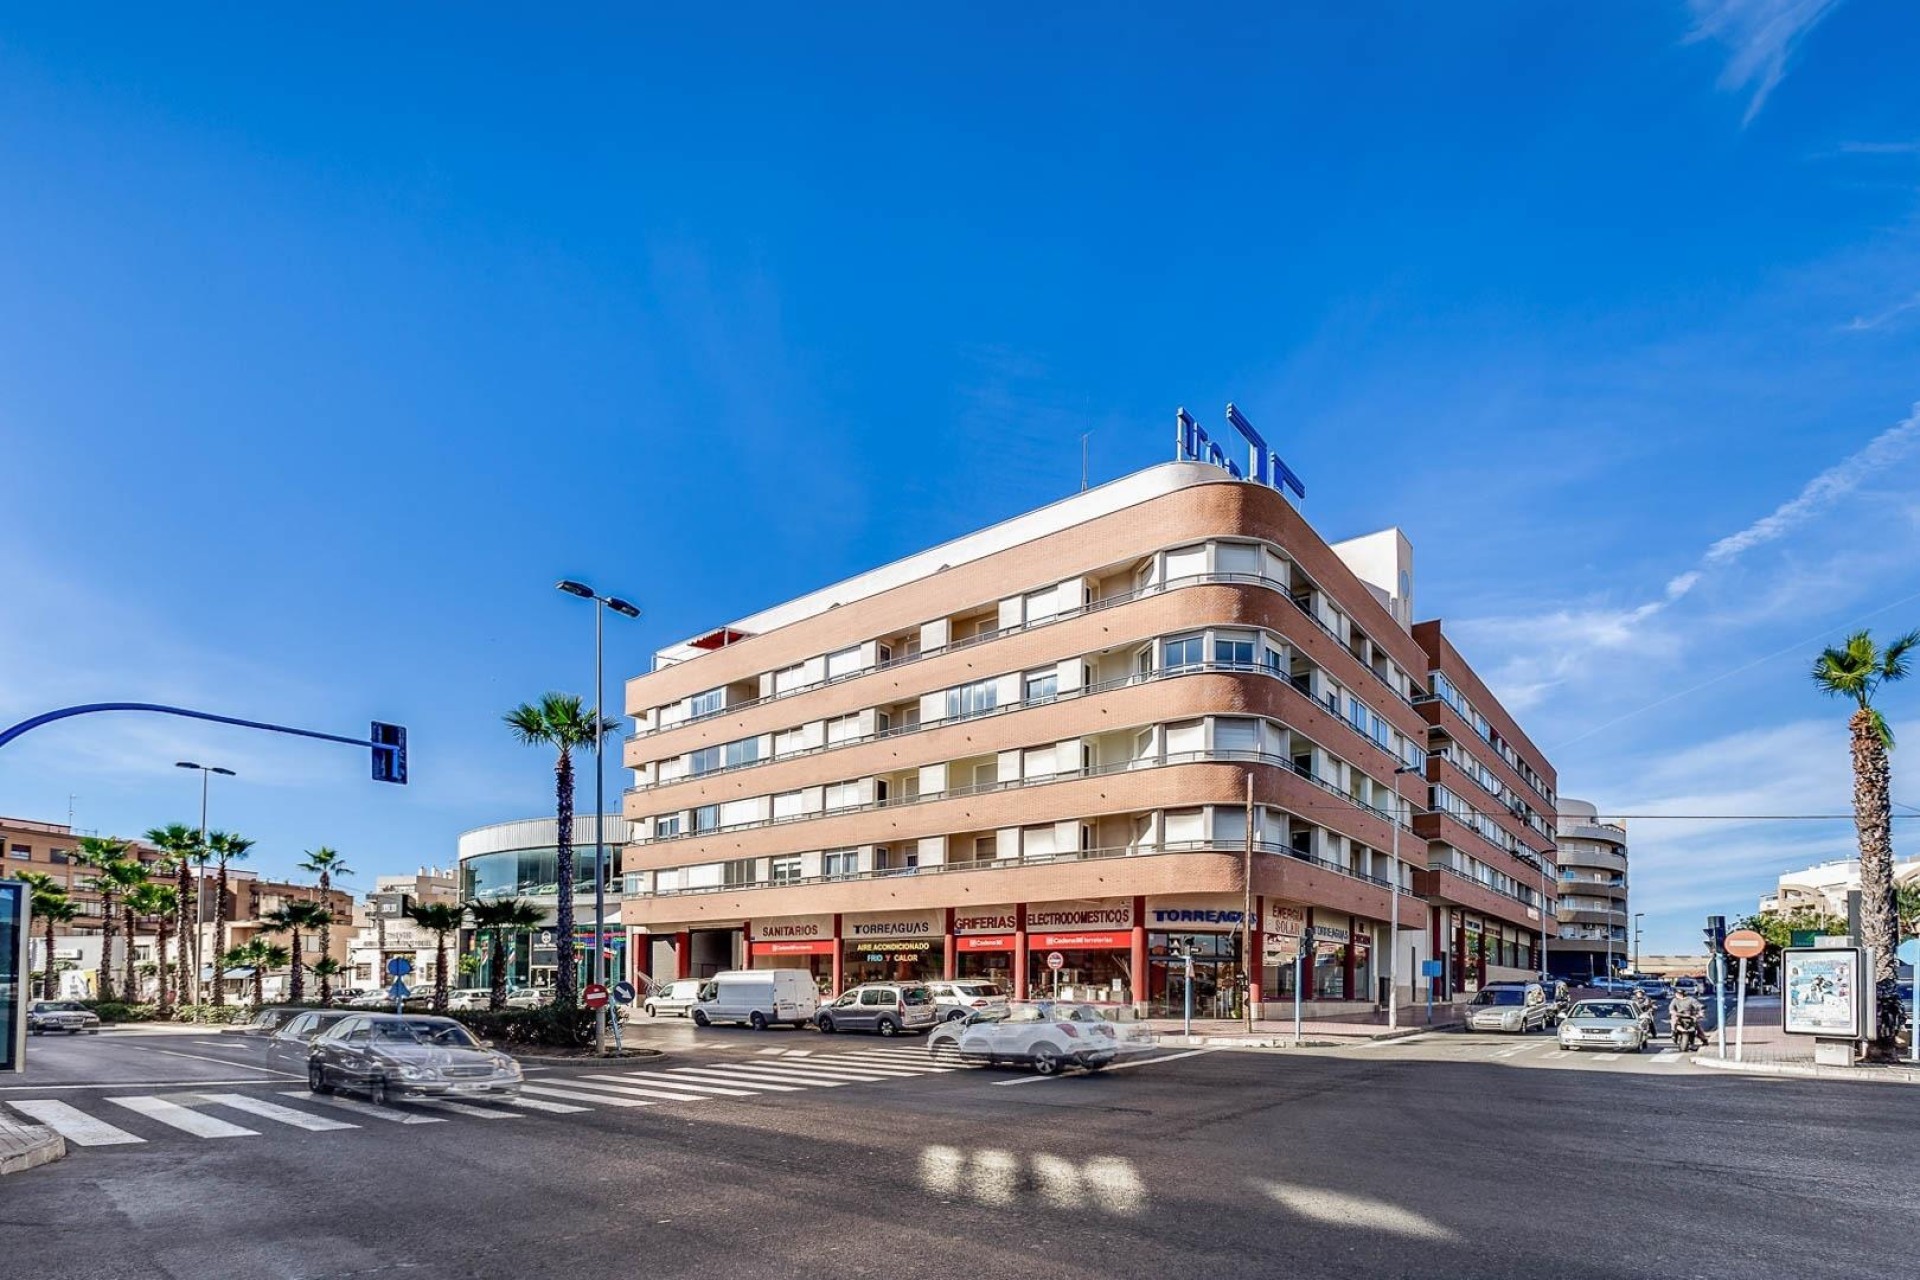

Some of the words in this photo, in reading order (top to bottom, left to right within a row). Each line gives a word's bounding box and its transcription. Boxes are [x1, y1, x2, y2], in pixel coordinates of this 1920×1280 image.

[1027, 909, 1129, 926] ELECTRODOMESTICOS
[1272, 904, 1304, 922] ENERGIA
[853, 921, 929, 935] TORREAGUAS
[954, 915, 1016, 930] GRIFERIAS
[1275, 919, 1300, 936] SOLAR
[762, 924, 818, 937] SANITARIOS
[857, 943, 872, 951] AIRE
[873, 942, 930, 951] ACONDICIONADO
[867, 954, 883, 962] FRIO
[893, 954, 918, 962] CALOR
